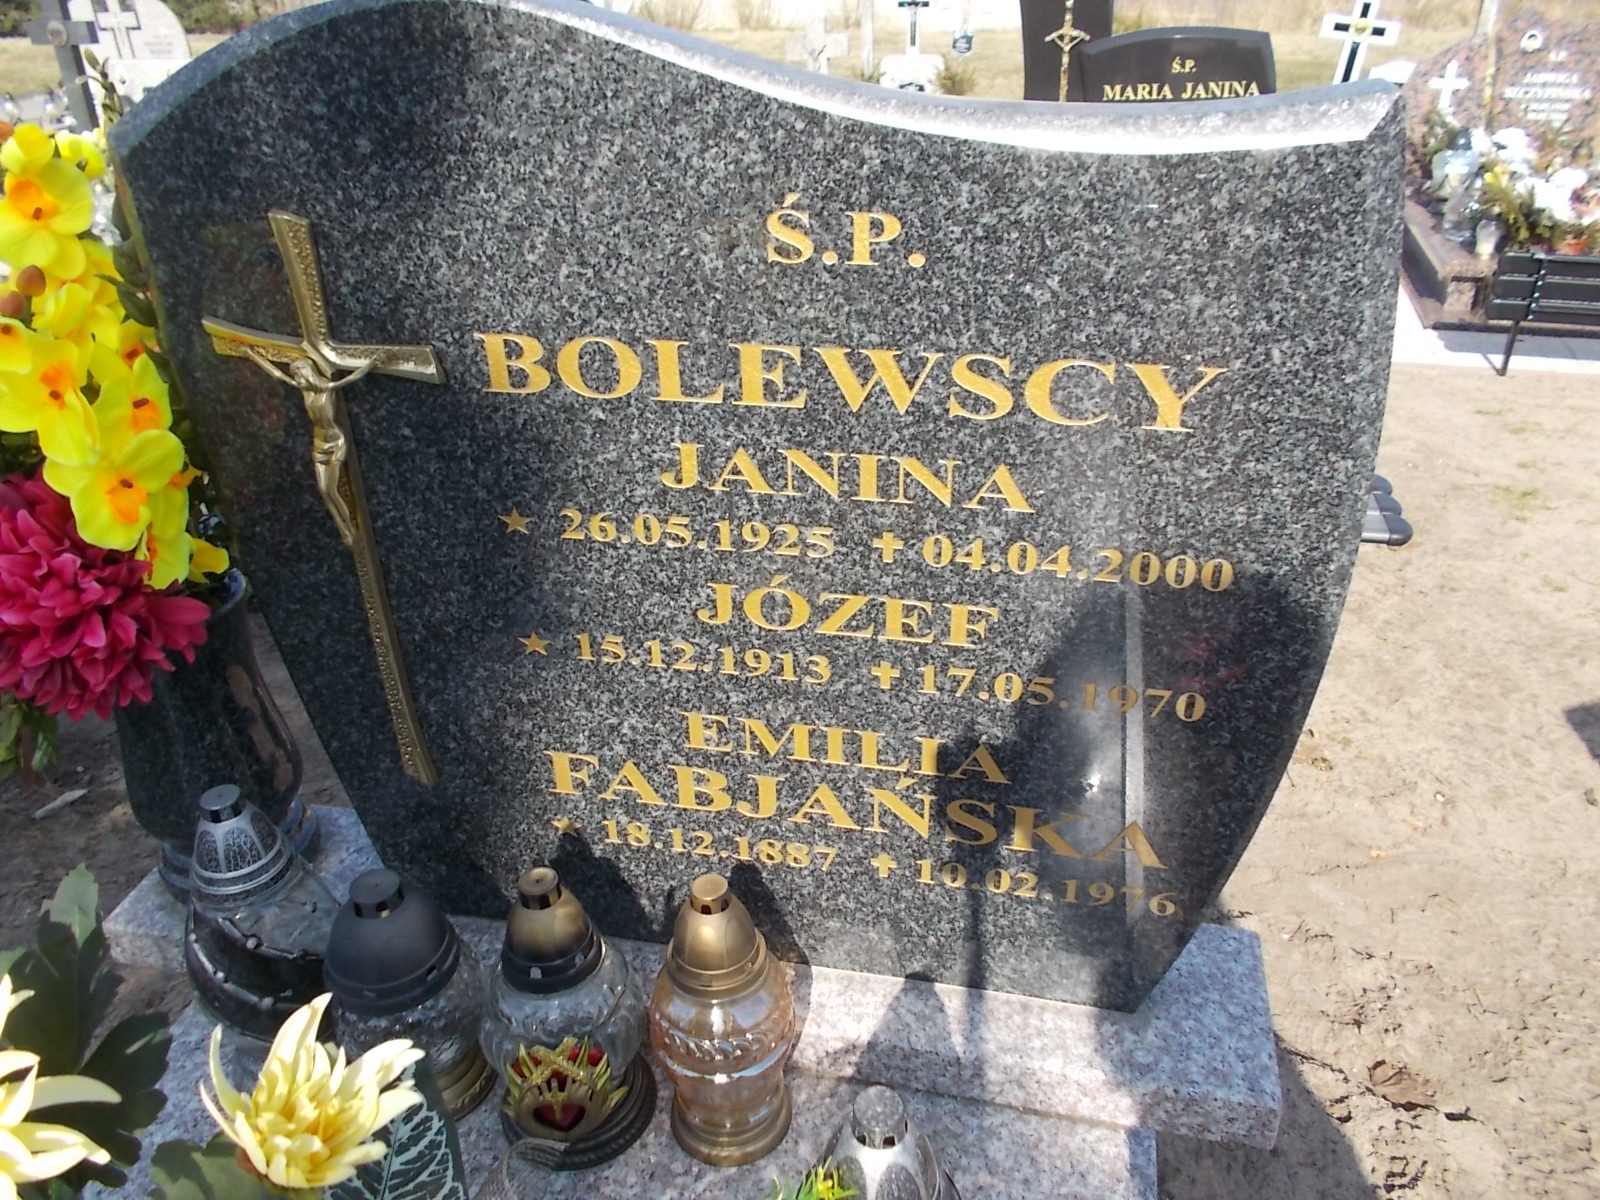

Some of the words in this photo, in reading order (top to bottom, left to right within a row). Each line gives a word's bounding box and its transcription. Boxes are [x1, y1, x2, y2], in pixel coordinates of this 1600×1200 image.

[1102, 83, 1173, 101] MARIA
[1181, 80, 1260, 99] JANINA
[766, 193, 927, 267] Ś.P.
[474, 332, 1228, 431] BOLEWSCY
[661, 442, 1035, 514] JANINA
[559, 508, 835, 558] 26.05.1925
[922, 534, 1234, 592] 04.04.2000
[696, 574, 1001, 648] JÓZEF
[576, 632, 831, 684] 15.12.1913
[918, 664, 1207, 723] 17.05.1970
[681, 711, 1011, 785] EMILIA
[543, 750, 1168, 870] FABJAŃSKA
[603, 818, 839, 872] 18.12.1887
[915, 858, 1179, 917] 10.02.1976
